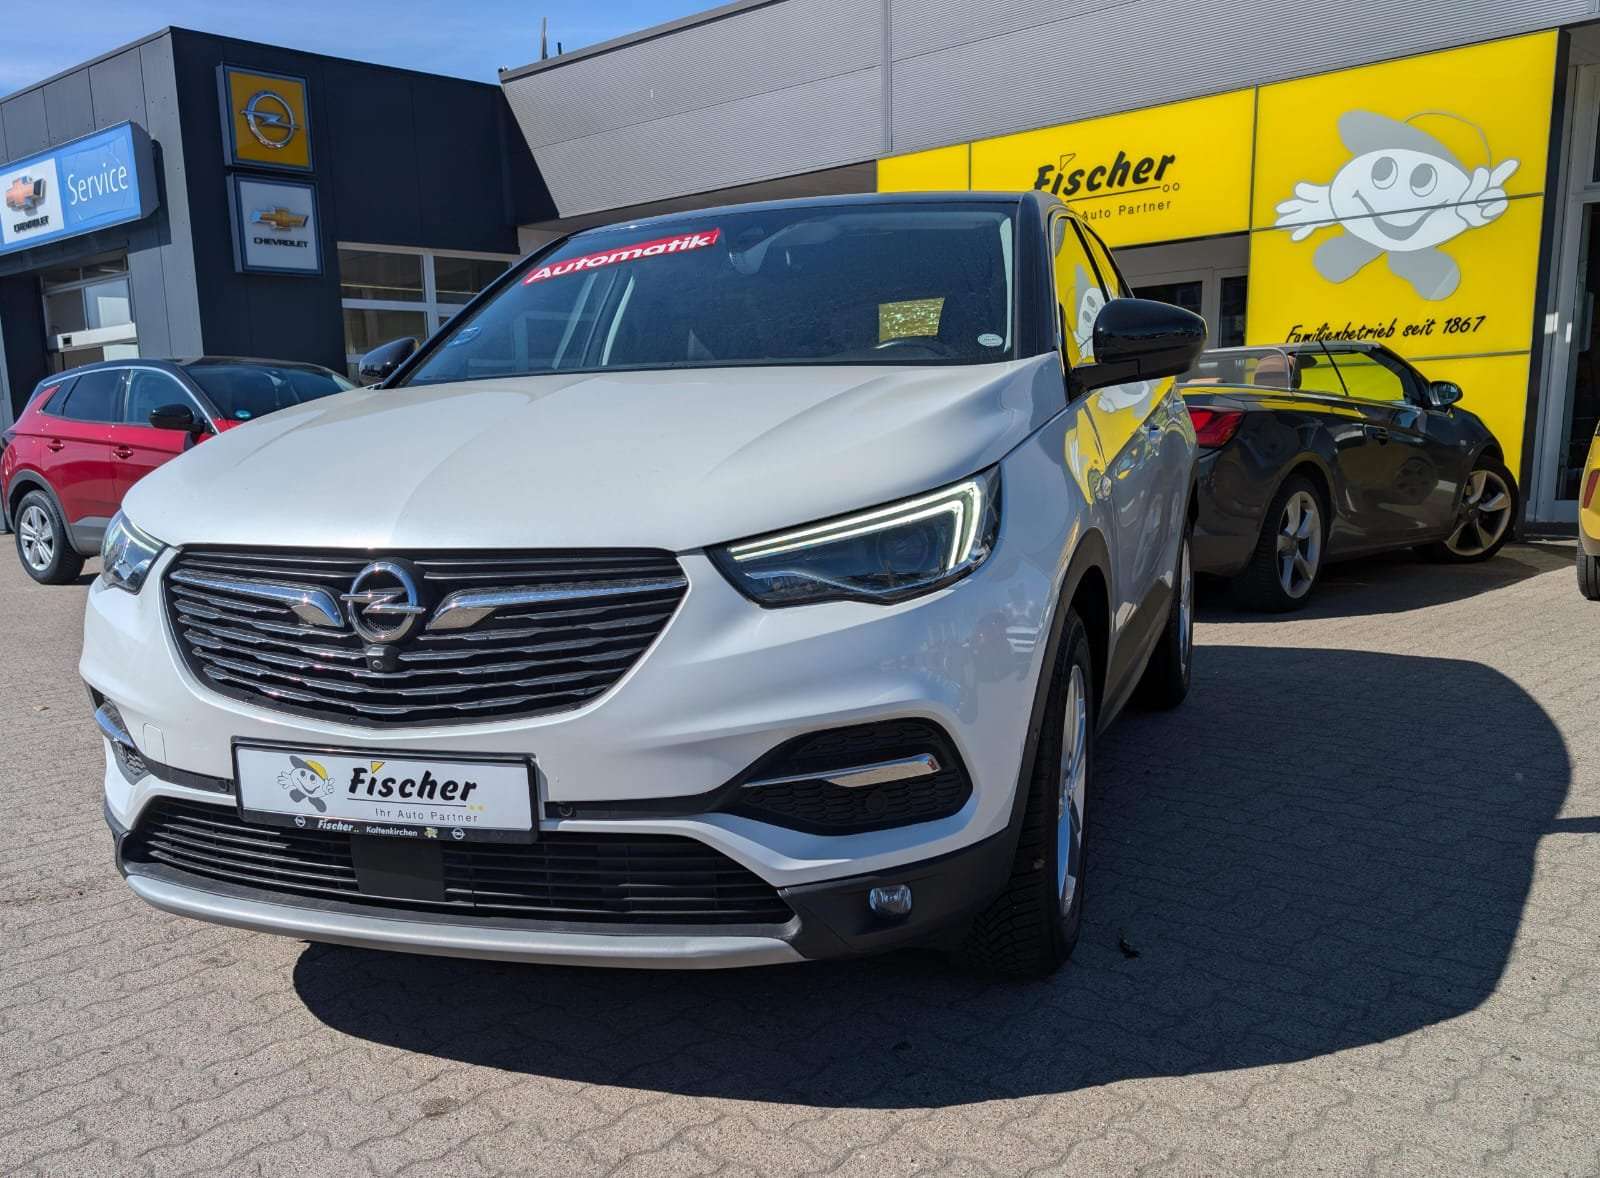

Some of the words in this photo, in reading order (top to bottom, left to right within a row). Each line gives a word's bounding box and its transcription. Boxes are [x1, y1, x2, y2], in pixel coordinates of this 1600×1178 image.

[68, 165, 129, 205] Service
[1034, 150, 1176, 196] Fischer
[1081, 208, 1112, 221] Auto
[1119, 199, 1172, 216] Partner
[253, 237, 309, 248] CHEVROLET
[525, 234, 711, 284] Automatik
[1286, 318, 1398, 343] Familienbetrieb
[1402, 318, 1436, 337] seit
[1442, 315, 1486, 334] 1867
[348, 766, 477, 802] Fischer
[318, 819, 354, 832] Fischer
[366, 825, 418, 837] Kaltenkirchen
[375, 808, 391, 818] Ihr
[397, 811, 424, 821] Auto
[430, 811, 479, 823] Partner
